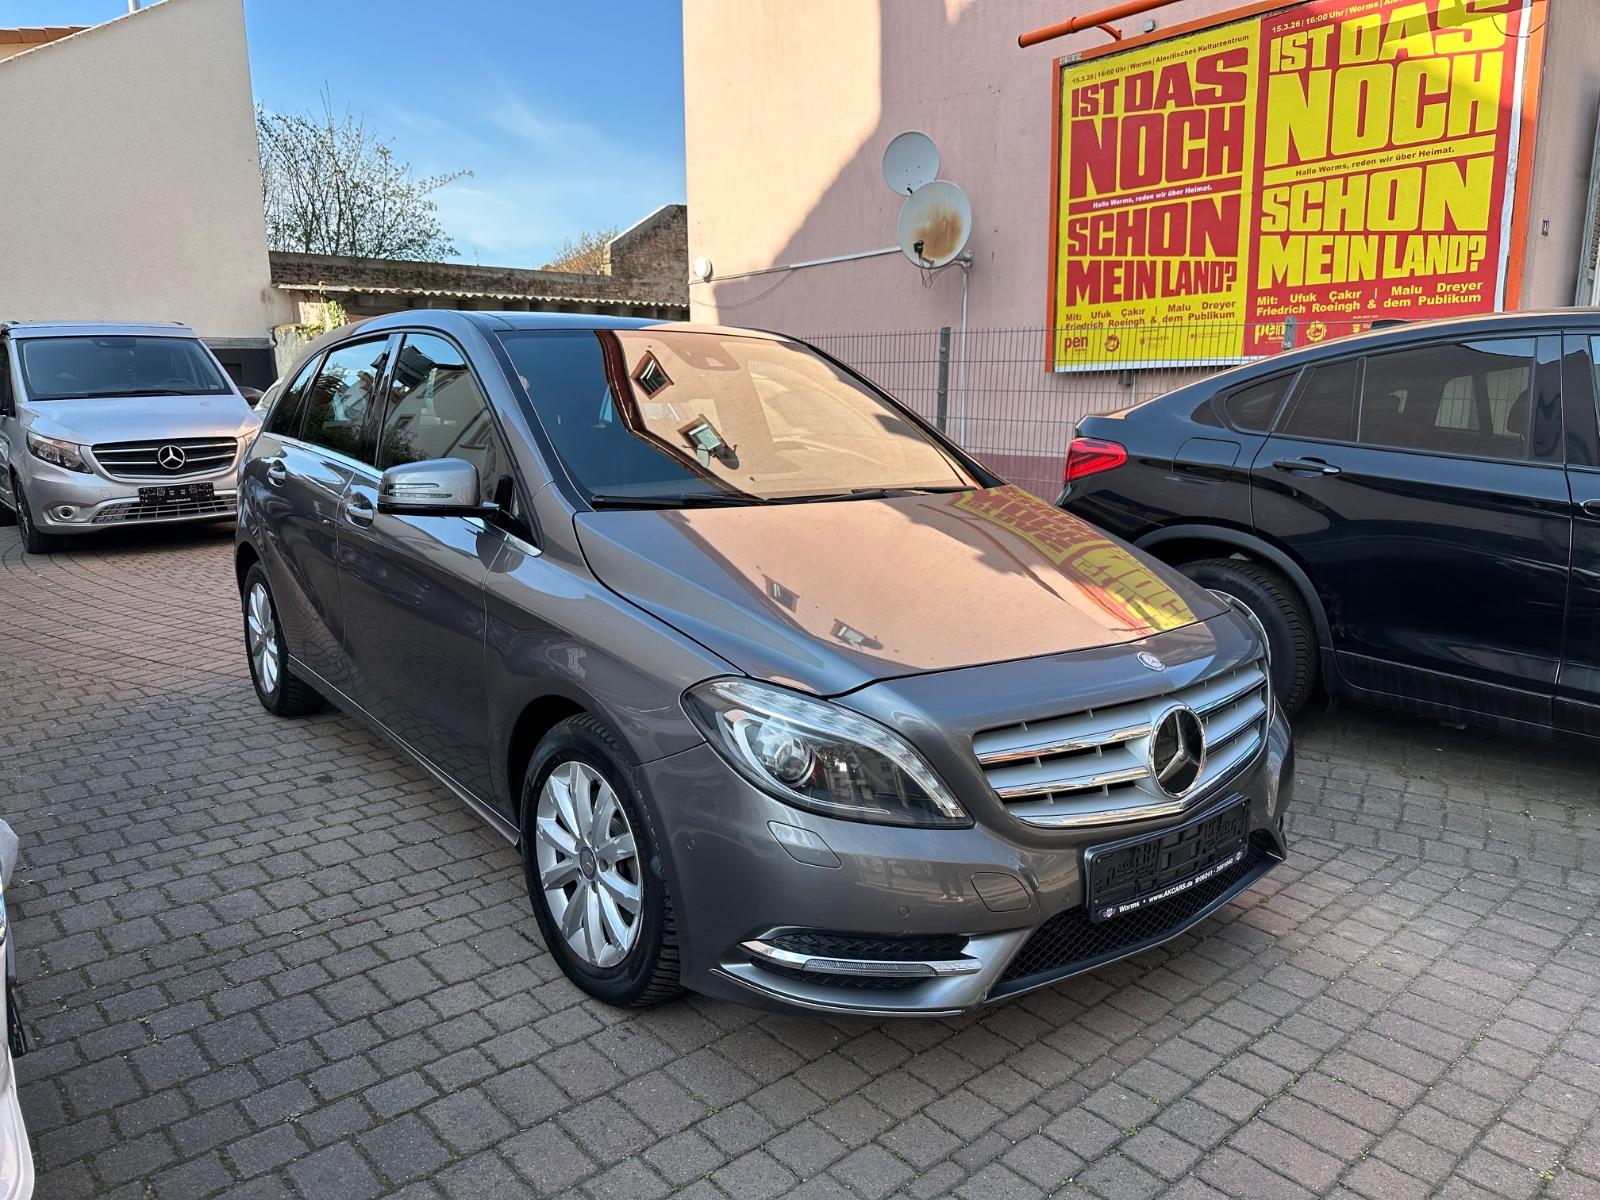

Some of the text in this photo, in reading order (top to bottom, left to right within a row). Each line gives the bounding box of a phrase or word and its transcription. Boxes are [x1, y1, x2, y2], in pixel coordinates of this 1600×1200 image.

[1272, 20, 1301, 33] 15.3.26
[1306, 13, 1327, 25] 16:00
[1329, 10, 1344, 19] Uhr
[1349, 2, 1379, 14] Worms
[1270, 0, 1508, 72] IST DAS
[1098, 69, 1114, 78] 16:00
[1115, 65, 1126, 73] Uhr
[1130, 60, 1152, 70] Worms
[1156, 48, 1197, 63] Alevitisches
[1197, 35, 1249, 52] Kulturzentrum
[1072, 47, 1248, 118] IST DAS
[1264, 51, 1504, 168] NOCH
[1069, 105, 1245, 199] NOCH
[1296, 146, 1455, 177] Hallo Worms, reden wir über Heimat.
[1093, 184, 1212, 208] Hallo Worms, reden wir über Heimat.
[1260, 156, 1494, 232] SCHON
[1067, 194, 1241, 257] SCHON
[1257, 235, 1486, 290] MEIN LAND?
[1066, 260, 1237, 307] MEIN LAND?
[1257, 297, 1278, 306] Mit:
[1290, 293, 1316, 303] Ufuk
[1328, 290, 1362, 302] Çakır
[1391, 285, 1422, 296] Malu
[1436, 282, 1483, 293] Dreyer
[1066, 311, 1235, 330] Friedrich Roeingh & dem Publikum
[1091, 310, 1111, 319] Ufuk
[1121, 308, 1146, 318] Çakır
[1168, 304, 1191, 313] Malu
[1202, 301, 1236, 311] Dreyer
[1256, 294, 1481, 316] Friedrich Roeingh & dem Publikum
[1065, 336, 1088, 352] pen
[1255, 322, 1285, 344] pen
[1119, 902, 1139, 912] Worms
[1149, 881, 1193, 902] www.AKCARS.de
